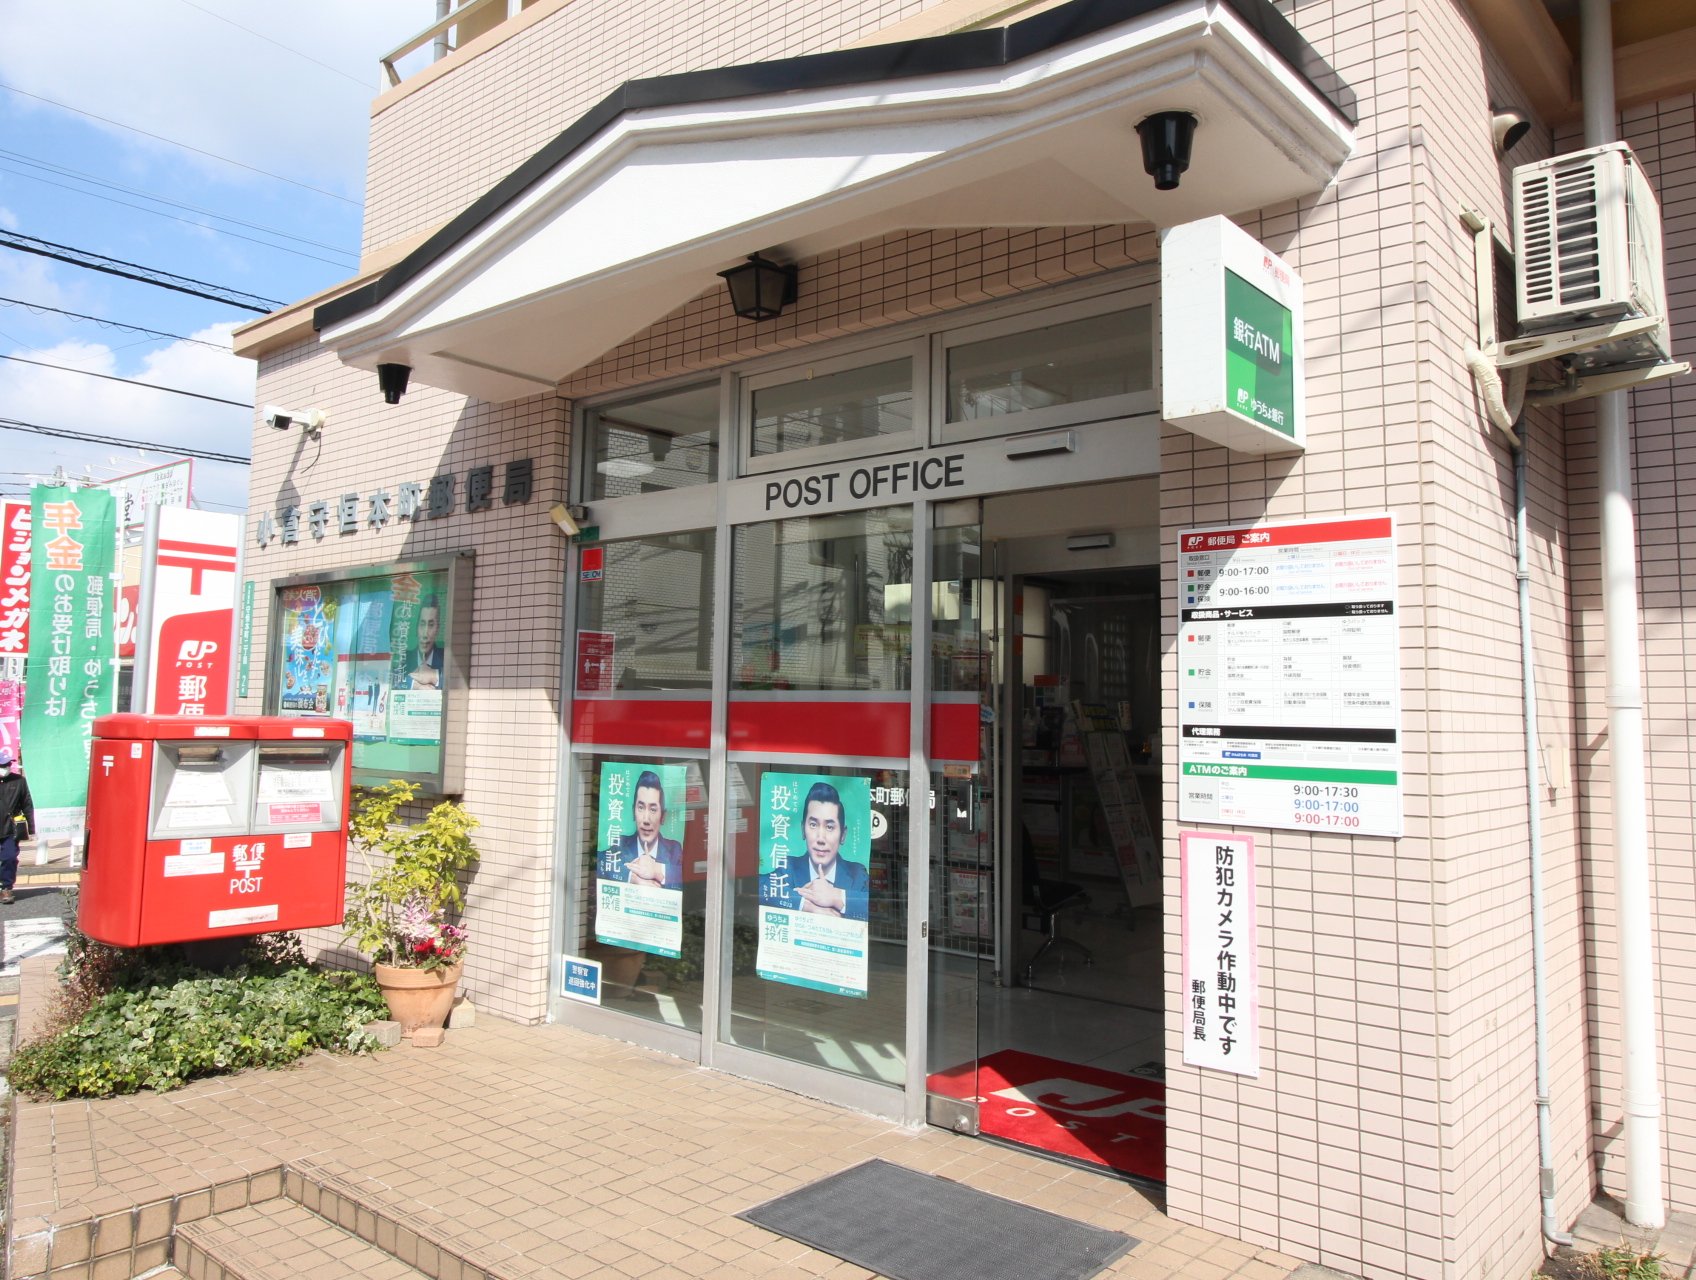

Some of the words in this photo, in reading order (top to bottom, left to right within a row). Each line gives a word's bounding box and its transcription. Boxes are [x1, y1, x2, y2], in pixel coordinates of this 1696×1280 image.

[1233, 316, 1280, 365] 銀行ATM
[1250, 398, 1284, 426] ゆうちょ銀行
[766, 472, 840, 511] POST
[850, 453, 965, 499] OFFICE
[256, 458, 533, 547] 小倉守恒本町郵便局
[1208, 535, 1235, 546] 郵便局
[1241, 532, 1270, 544] ご案内
[1198, 569, 1211, 577] 郵便
[1218, 566, 1269, 577] 9:00-17:00
[1219, 586, 1270, 596] 9:00-16:00
[1191, 609, 1254, 619] 取扱商品・サービス
[178, 640, 218, 661] JP
[1191, 727, 1221, 736] 代理業務
[1189, 765, 1248, 777] ATMのご案内
[1293, 784, 1359, 799] 9:00-17:30
[1294, 798, 1359, 813] 9:00-17:00
[605, 773, 625, 873] 投資信託
[1294, 812, 1360, 828] 9:00-17:00
[769, 785, 791, 899] 投資信託
[232, 843, 266, 862] 郵便
[230, 877, 264, 894] POST
[602, 895, 621, 911] 投信
[766, 914, 788, 924] ゆうちょ
[765, 925, 789, 943] 投信
[1215, 845, 1237, 1056] 防犯カメラ作動中です
[1192, 979, 1206, 1042] 郵便局長
